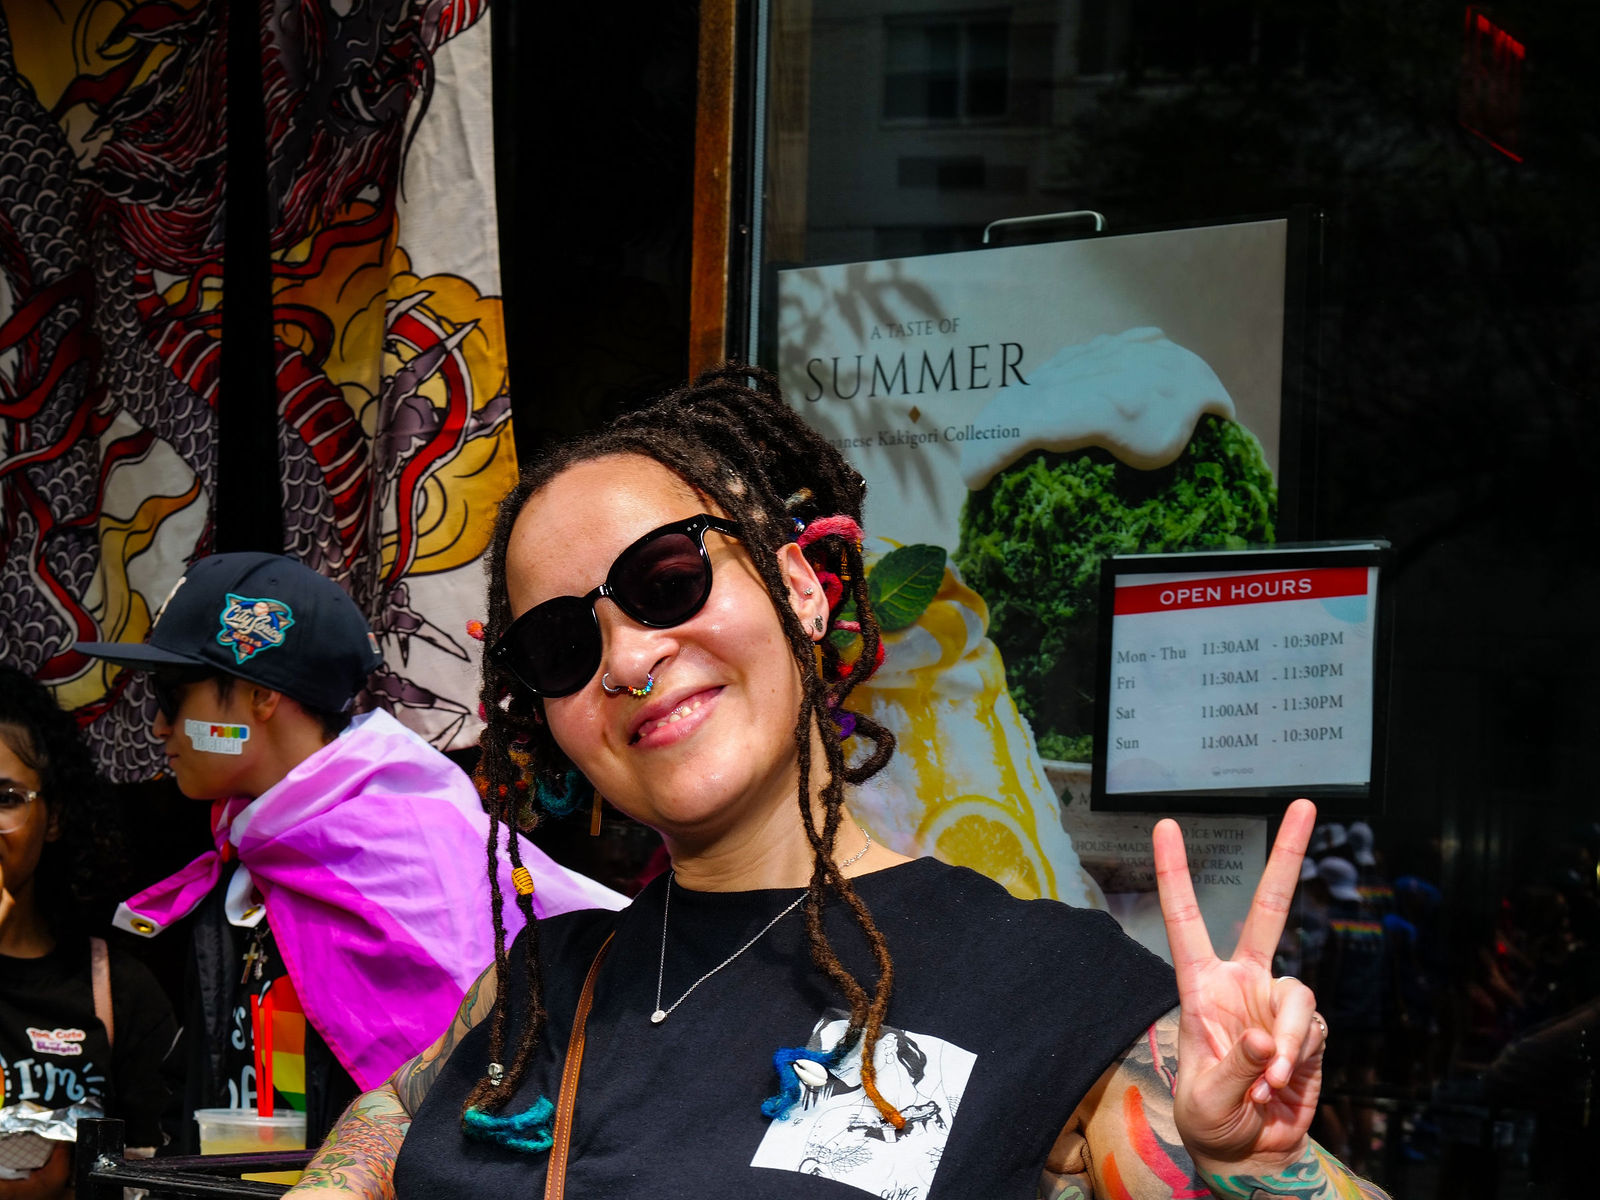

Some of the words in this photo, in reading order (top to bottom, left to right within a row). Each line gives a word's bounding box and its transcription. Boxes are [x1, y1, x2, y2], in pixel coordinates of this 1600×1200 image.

[870, 328, 882, 340] A
[886, 320, 933, 338] TASTE
[939, 318, 960, 334] OF
[804, 342, 1031, 402] SUMMER
[878, 429, 939, 448] Kakigori
[944, 425, 1021, 442] Collection
[1159, 585, 1222, 605] OPEN
[1230, 578, 1313, 600] HOURS
[1116, 650, 1148, 664] Mon
[1160, 646, 1187, 661] Thu
[1202, 638, 1260, 656] 11:30AM
[1283, 631, 1344, 649] 10:30PM
[1116, 676, 1136, 690] Fri
[1201, 669, 1259, 686] 11:30AM
[1282, 663, 1344, 680] 11:30PM
[1115, 706, 1136, 719] Sat
[1201, 702, 1259, 718] 11:00AM
[1282, 694, 1344, 712] 11:30PM
[1115, 737, 1140, 750] Sun
[1201, 733, 1259, 749] 11:00AM
[1282, 726, 1344, 743] 10:30PM
[1213, 828, 1244, 840] WITH
[1201, 857, 1243, 871] CREAM
